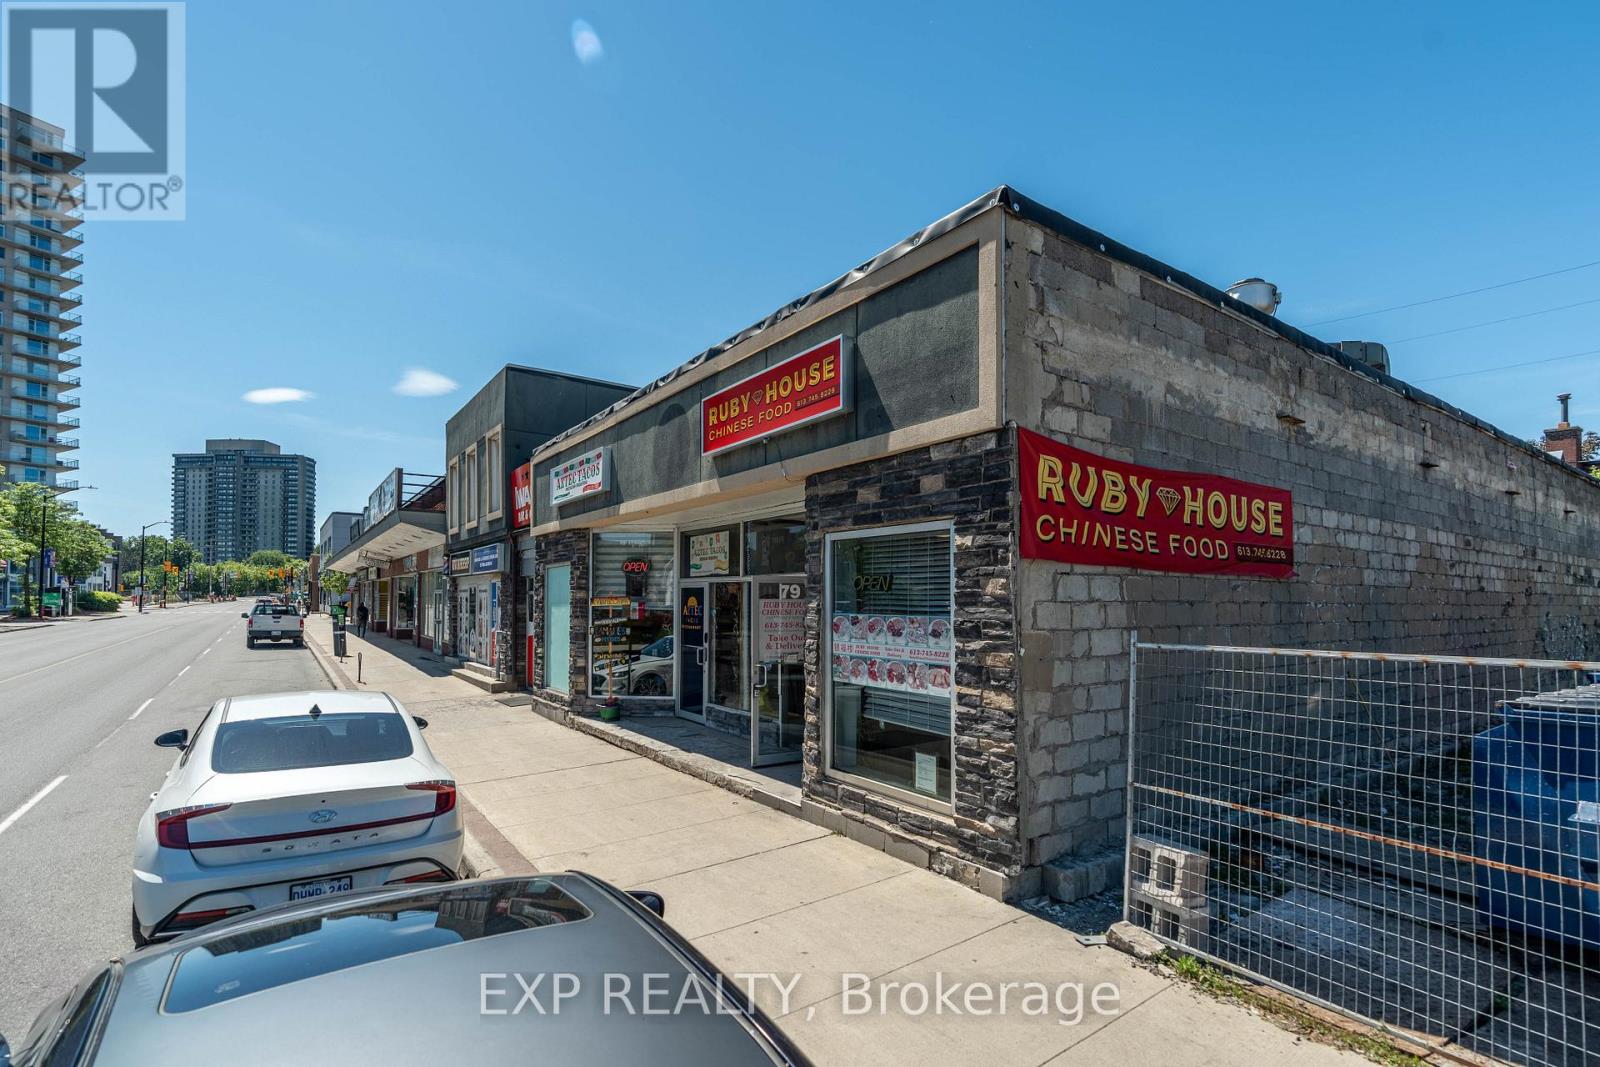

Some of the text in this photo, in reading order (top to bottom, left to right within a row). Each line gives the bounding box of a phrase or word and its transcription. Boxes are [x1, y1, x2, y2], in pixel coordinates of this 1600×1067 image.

[708, 355, 835, 426] RUBY HOUSE
[708, 416, 754, 441] CHINESE
[758, 402, 792, 424] FOOD
[556, 473, 577, 491] AZTEC
[577, 462, 600, 482] TACOS
[1037, 454, 1284, 536] RUBY HOUSE
[1036, 514, 1160, 554] CHINESE
[1169, 534, 1229, 560] FOOD
[623, 562, 649, 572] OPEN
[853, 576, 890, 591] OPEN
[762, 608, 793, 616] CHINESE
[763, 601, 806, 609] RUBY HOU
[768, 634, 789, 642] Take
[262, 832, 380, 853] SONATA
